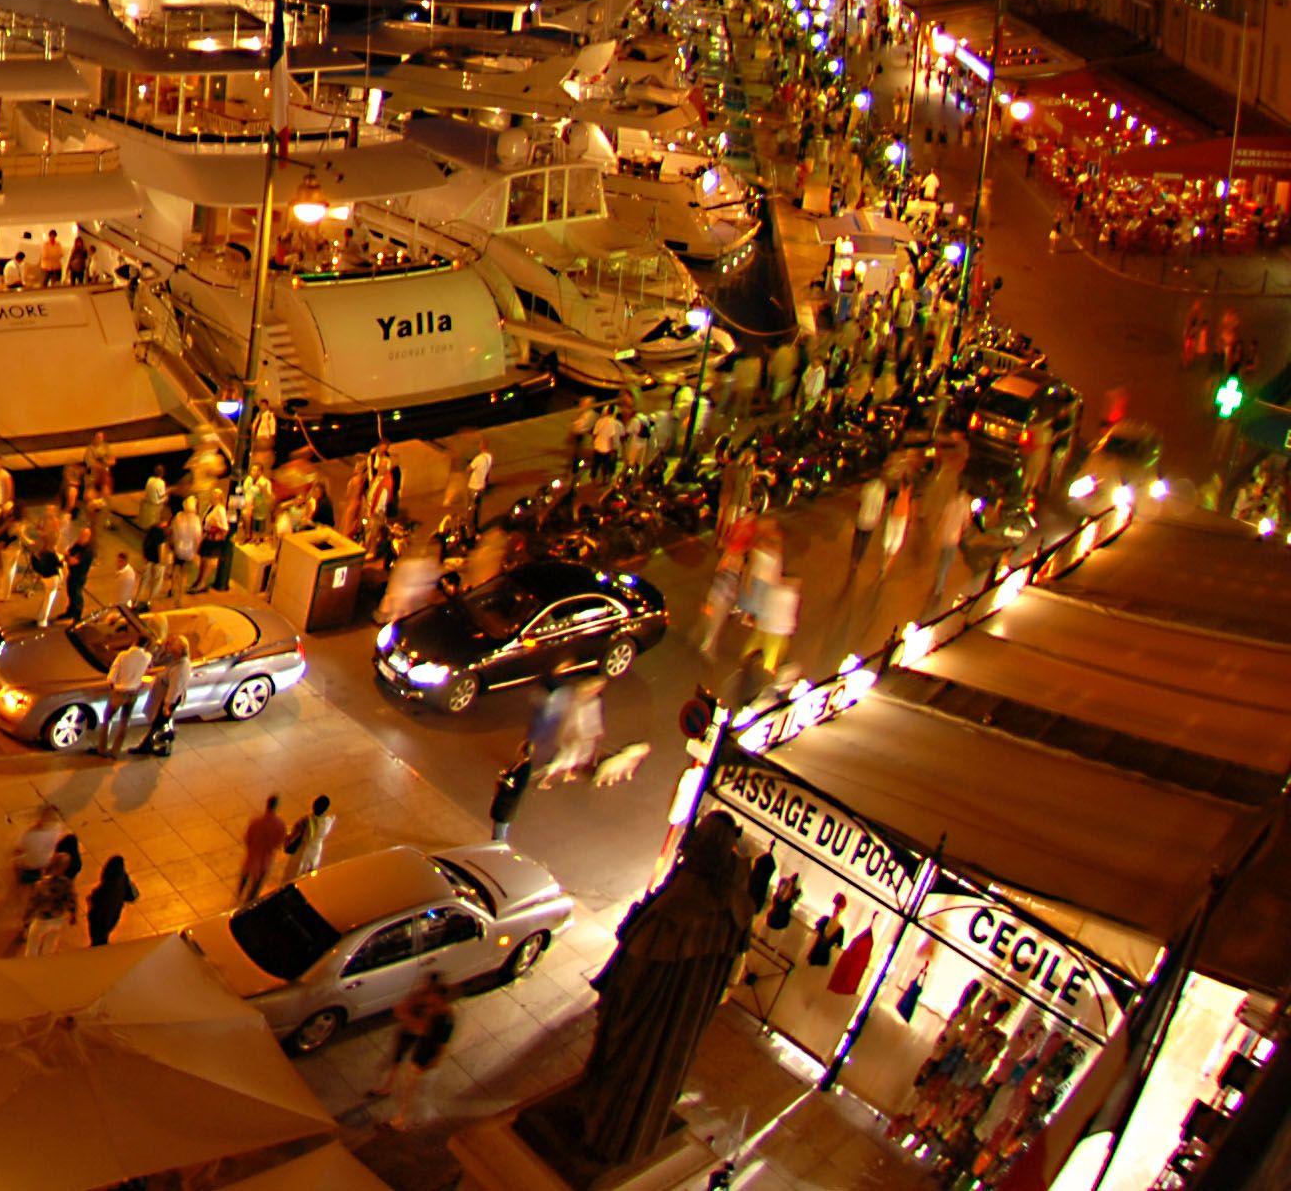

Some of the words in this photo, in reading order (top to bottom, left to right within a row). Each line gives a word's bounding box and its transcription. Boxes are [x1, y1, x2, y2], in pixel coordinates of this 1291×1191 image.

[376, 311, 452, 341] Yalla
[720, 764, 818, 837] PASSAGE
[815, 814, 852, 857] DU
[969, 907, 1090, 1006] CECILE
